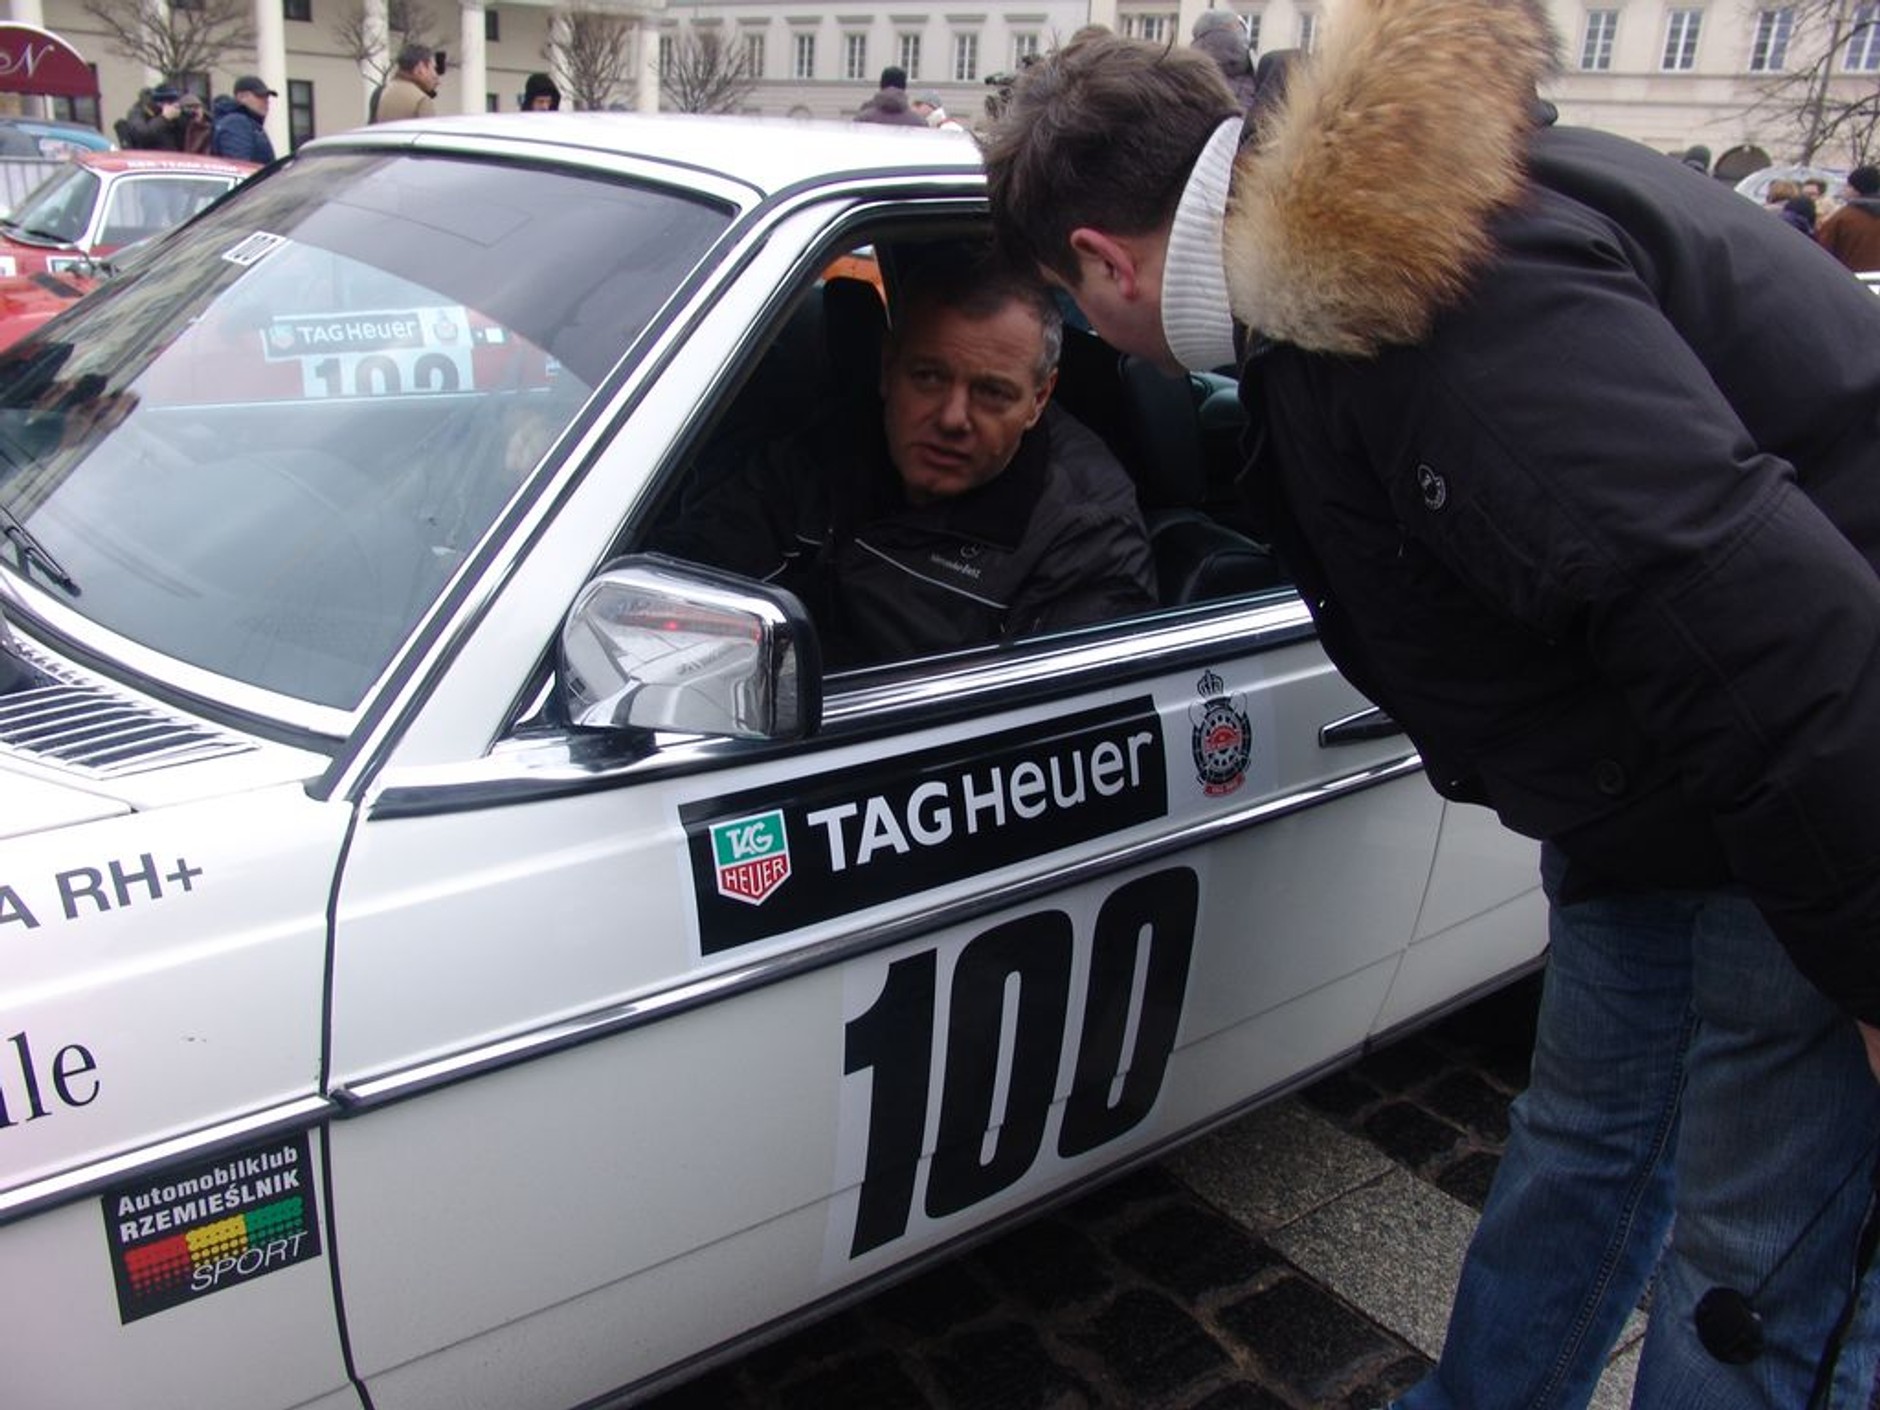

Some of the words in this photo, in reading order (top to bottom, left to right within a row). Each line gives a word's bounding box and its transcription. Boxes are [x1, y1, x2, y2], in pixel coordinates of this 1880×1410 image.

[725, 821, 775, 859] TAG
[55, 852, 203, 920] RH+
[724, 857, 785, 896] HEUER
[0, 1031, 99, 1129] le
[844, 866, 1199, 1260] 100
[118, 1146, 298, 1217] Automobilklub
[119, 1169, 300, 1243] RZEMIEŚLNIK
[191, 1230, 308, 1291] SPORT
